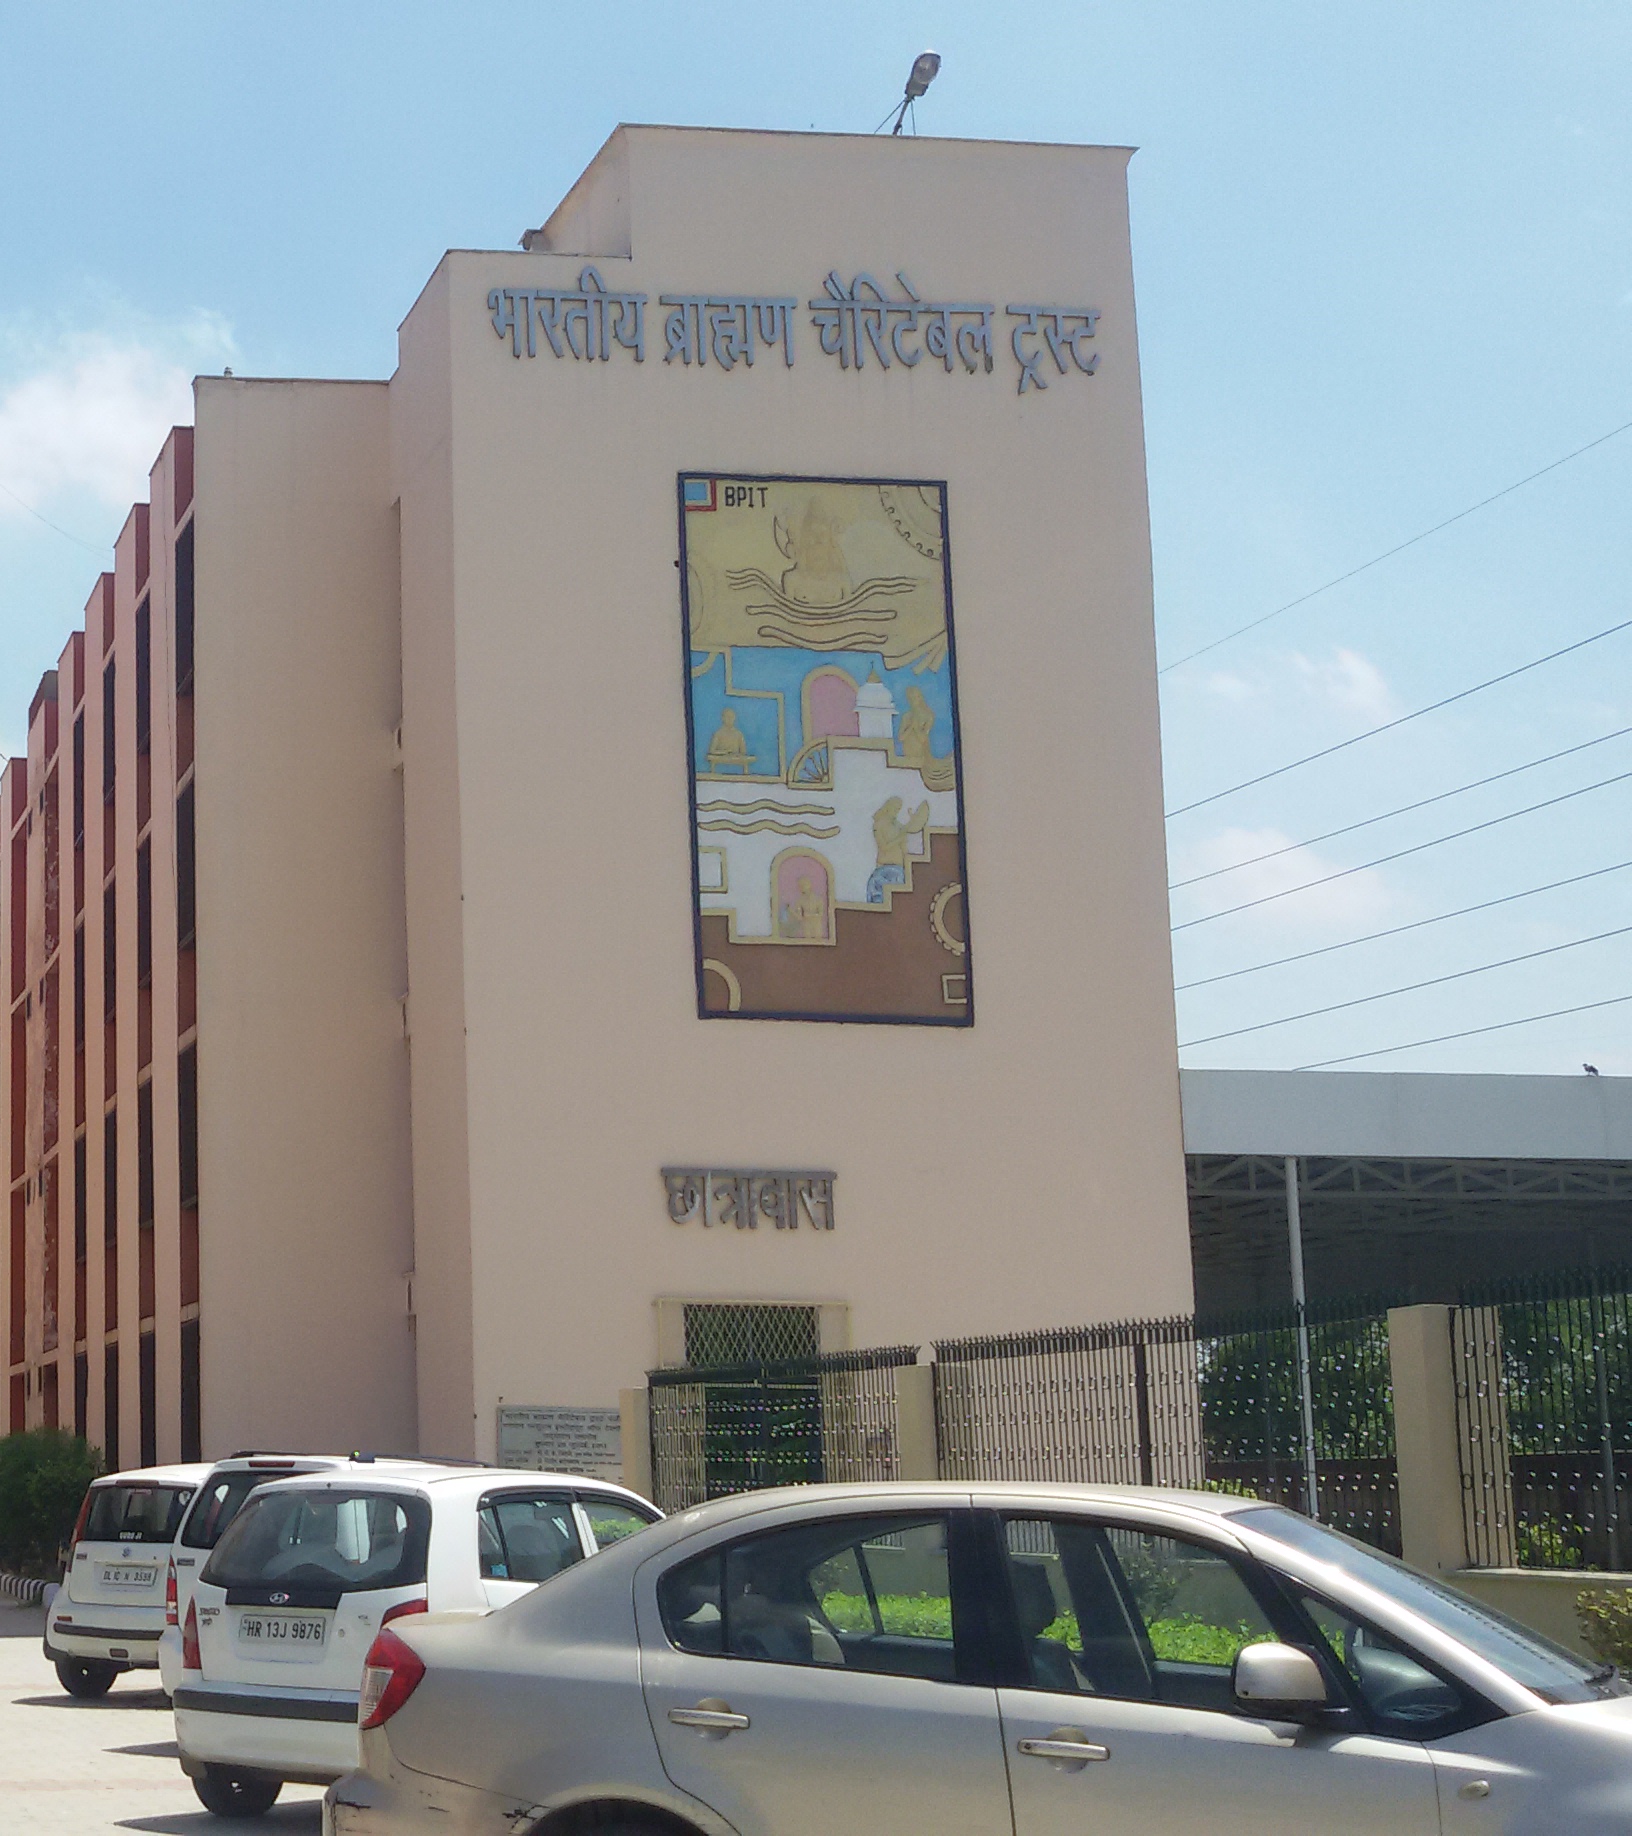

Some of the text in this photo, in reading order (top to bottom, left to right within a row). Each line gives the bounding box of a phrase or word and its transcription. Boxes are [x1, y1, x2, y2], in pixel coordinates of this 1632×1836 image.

[487, 265, 647, 364] भारतीय
[659, 294, 798, 372] ब्राह्मण
[1005, 303, 1102, 395] ट्रस्ट
[724, 485, 769, 508] BPIT
[661, 1167, 838, 1231] छात्रावास
[246, 1620, 322, 1640] HR 13J 9876
